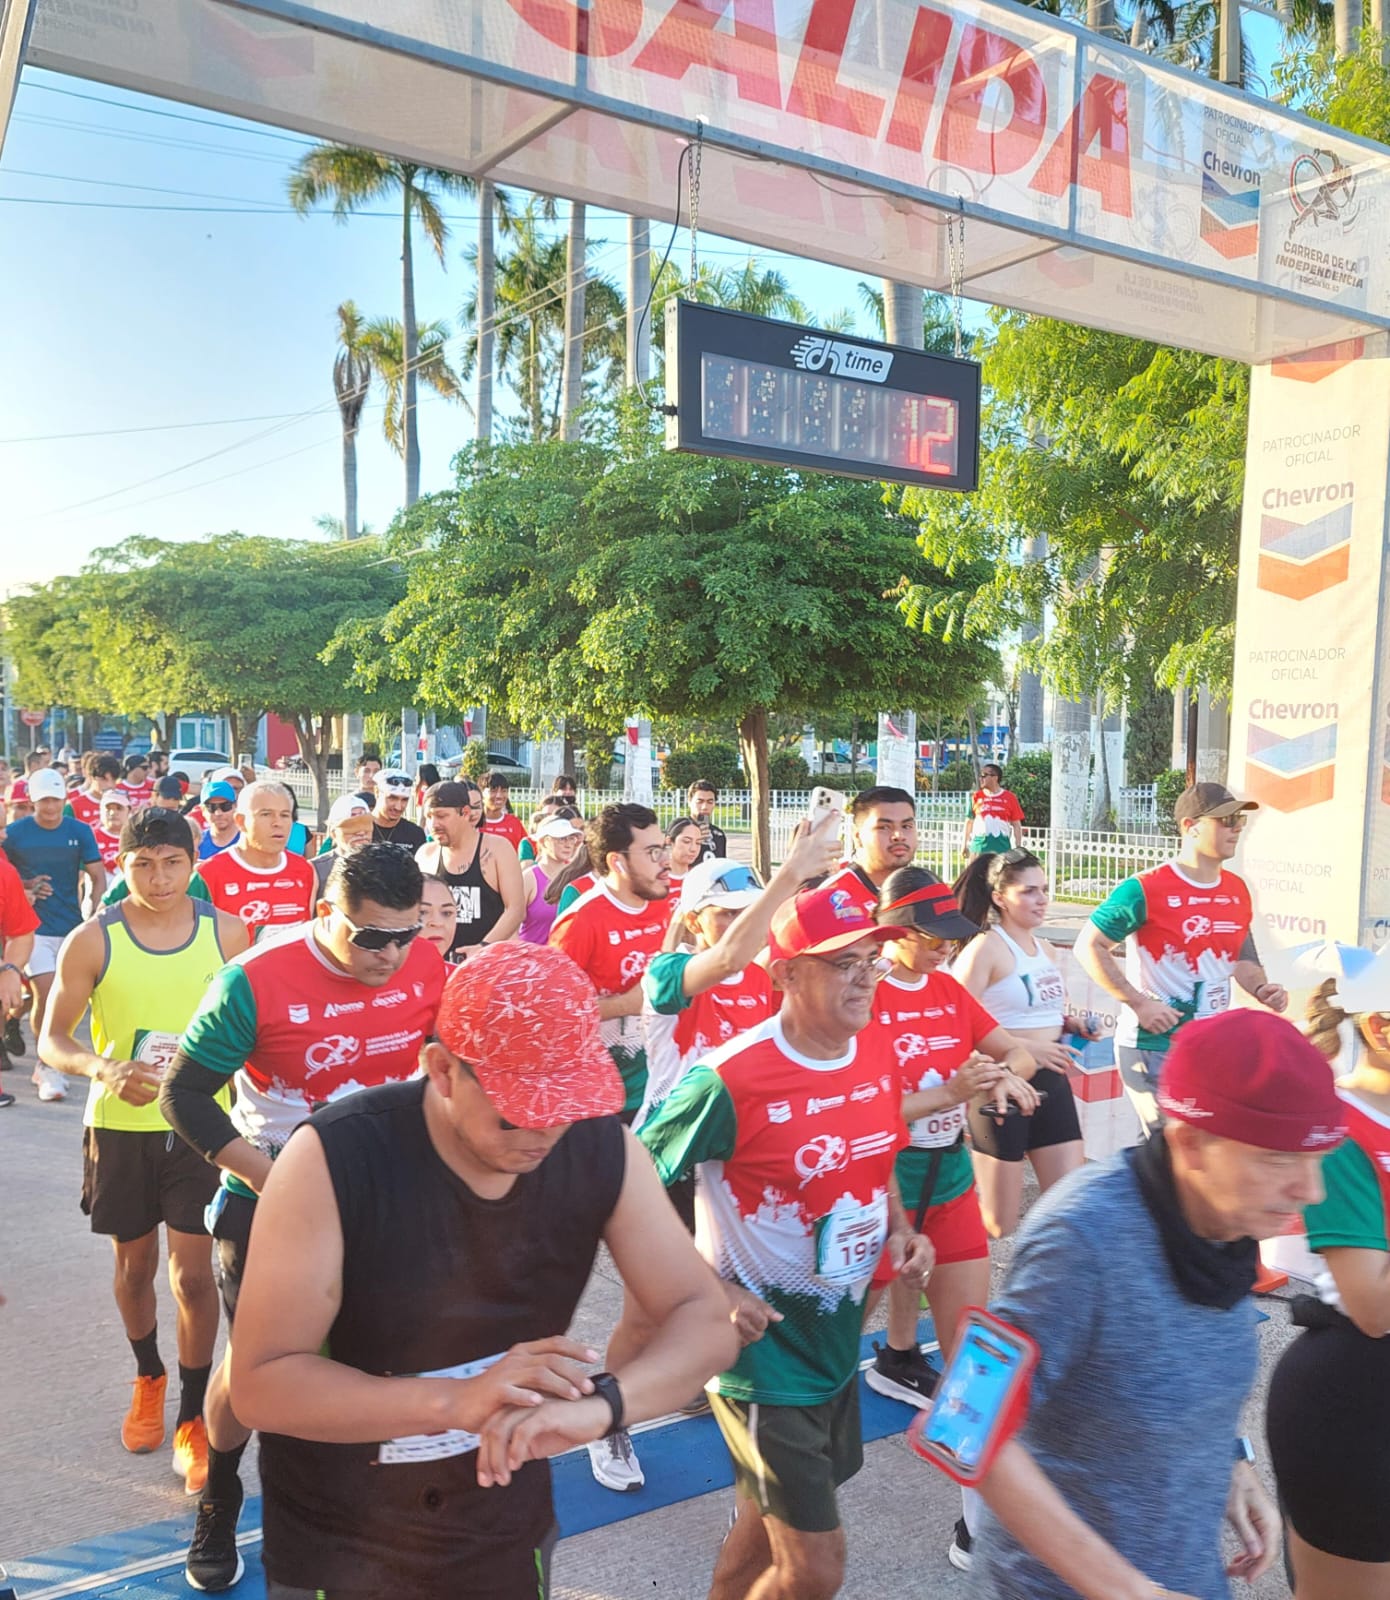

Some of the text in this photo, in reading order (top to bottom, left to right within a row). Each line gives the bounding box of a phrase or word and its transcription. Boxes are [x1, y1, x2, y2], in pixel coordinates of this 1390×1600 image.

[1203, 150, 1261, 187] Chevron
[1283, 240, 1359, 275] CARRERA DE LA
[1275, 254, 1364, 289] INDEPENDENCIA
[844, 350, 883, 374] time
[909, 397, 955, 475] 12
[1263, 424, 1361, 453] PATROCINADOR
[1285, 449, 1334, 468] OFICIAL
[1262, 481, 1355, 510] Chevron
[1249, 647, 1346, 664] PATROCINADOR
[1271, 667, 1319, 681] OFICIAL
[1248, 698, 1340, 720] Chevron
[1264, 912, 1327, 935] evron
